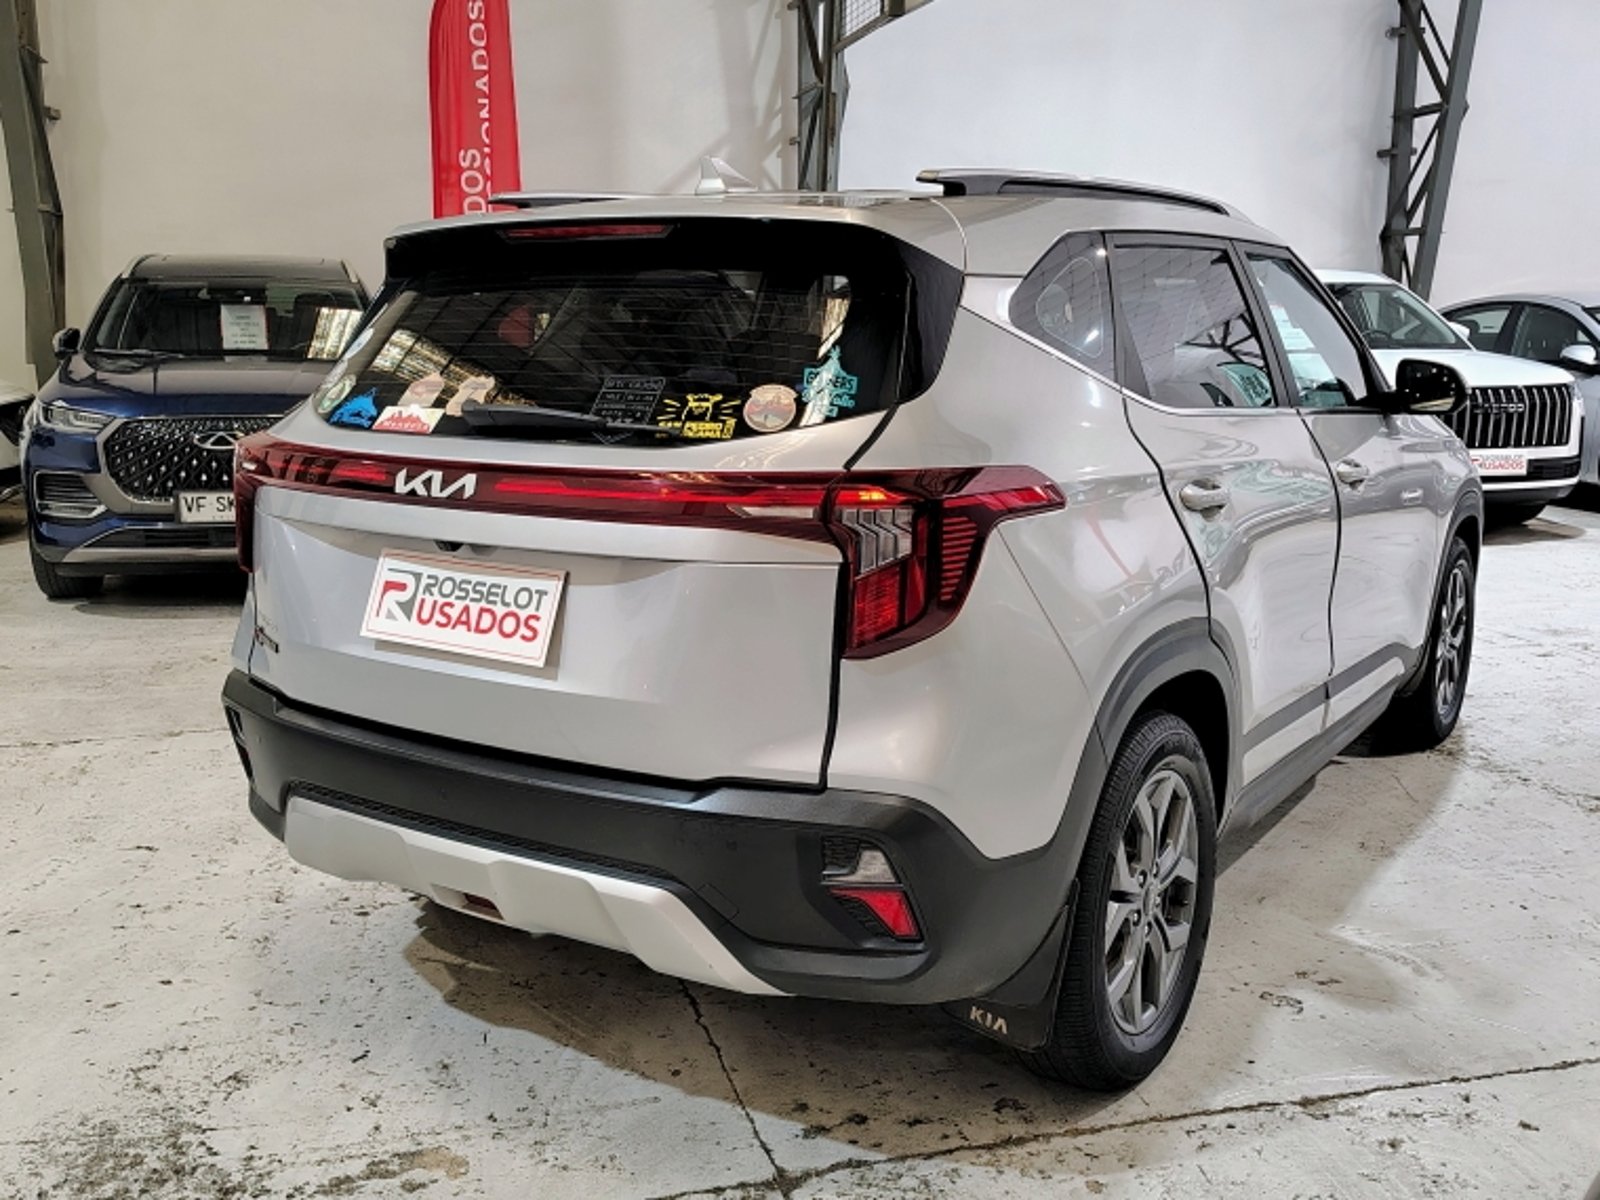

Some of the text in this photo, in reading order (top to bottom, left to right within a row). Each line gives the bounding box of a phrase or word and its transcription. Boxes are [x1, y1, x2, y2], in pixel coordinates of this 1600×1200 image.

[395, 466, 477, 500] KIA
[182, 495, 207, 513] VF
[421, 574, 548, 612] ROSSELOT
[416, 597, 542, 643] USADOS
[970, 1005, 1008, 1035] KIA
